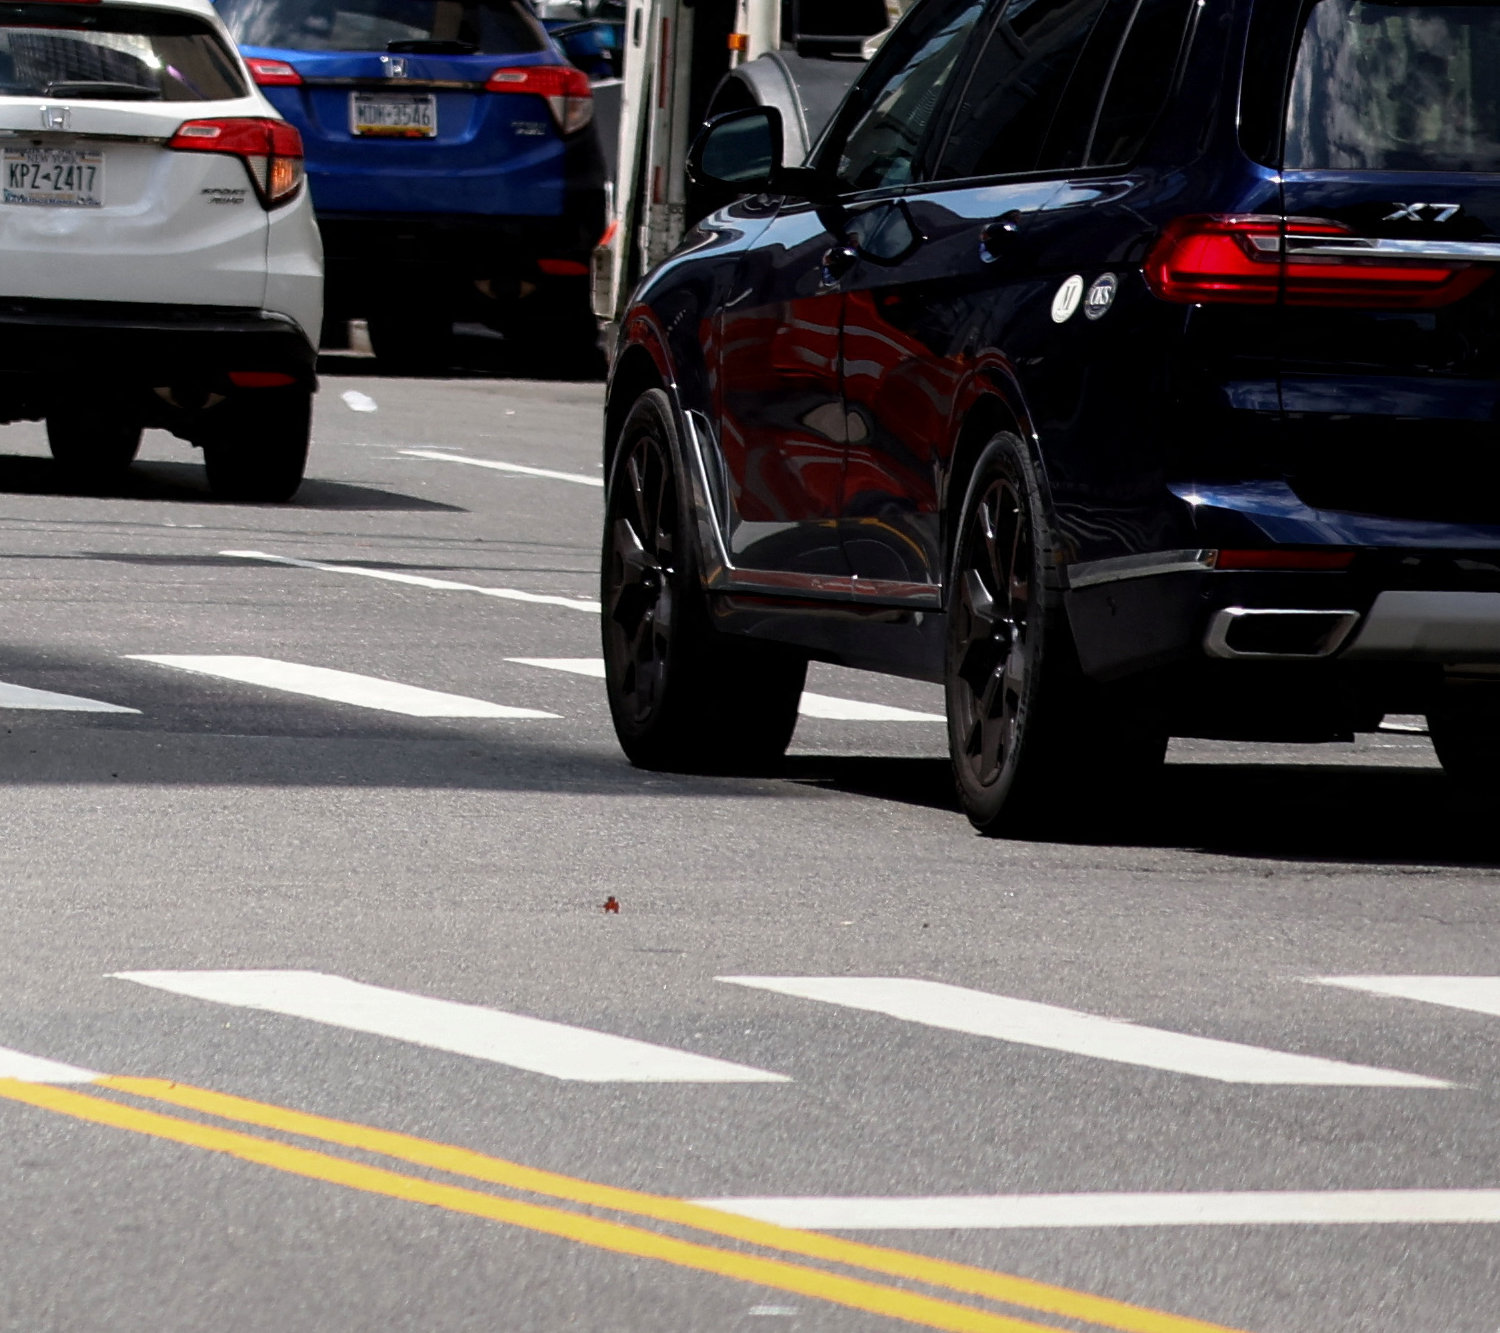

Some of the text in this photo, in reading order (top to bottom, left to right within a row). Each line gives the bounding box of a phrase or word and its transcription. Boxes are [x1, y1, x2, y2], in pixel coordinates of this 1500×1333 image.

[27, 152, 78, 166] NEW YORK
[9, 164, 97, 192] KPZ 2417
[1381, 202, 1461, 222] X7
